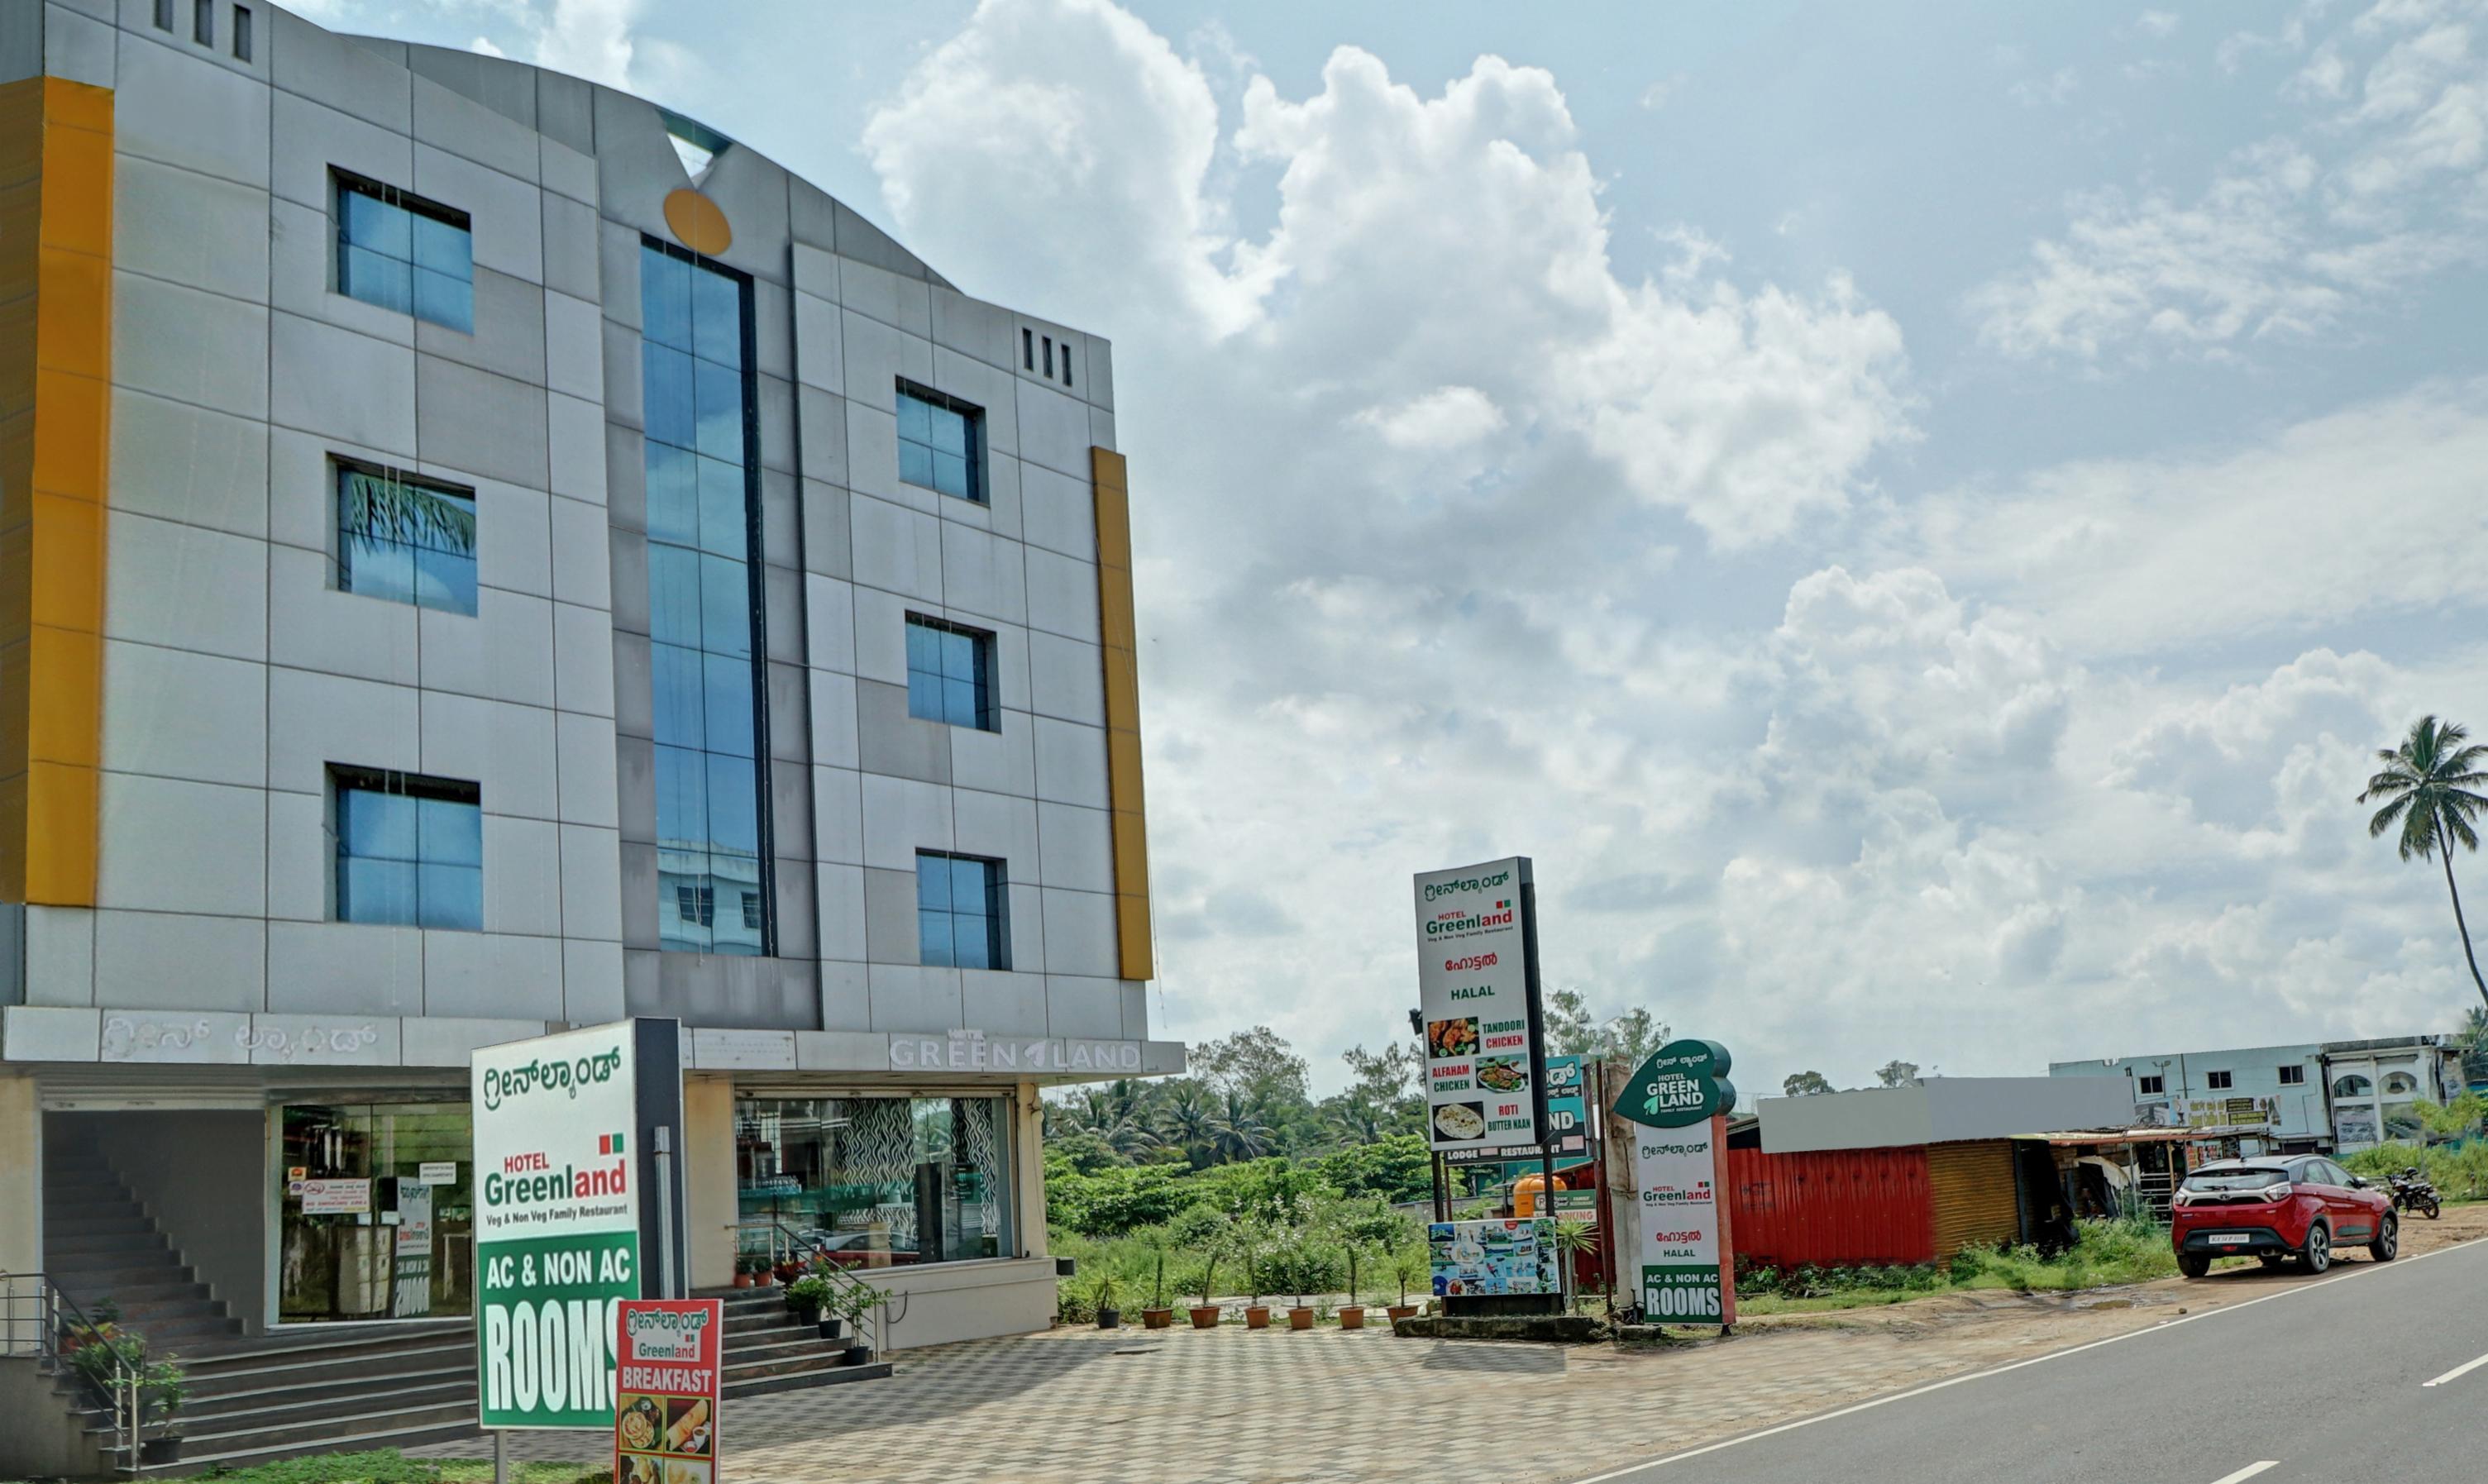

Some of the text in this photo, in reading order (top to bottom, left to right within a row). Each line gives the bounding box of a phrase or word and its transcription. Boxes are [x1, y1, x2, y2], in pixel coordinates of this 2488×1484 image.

[1426, 909, 1512, 934] Greenland
[1438, 911, 1466, 921] HOTEL
[1451, 985, 1495, 1000] HALAL
[1483, 1019, 1525, 1033] TANDOORI
[1486, 1035, 1523, 1048] CHICKEN
[890, 1039, 1141, 1068] GREEN LAND
[1432, 1065, 1469, 1078] ALFAHAM
[1658, 1073, 1686, 1081] HOTEL
[1434, 1080, 1469, 1092] CHICKEN
[1646, 1079, 1699, 1096] GREEN
[1659, 1092, 1704, 1108] LAND
[1498, 1105, 1518, 1116] ROTI
[1488, 1118, 1531, 1132] BUTTER NAAN
[1447, 1144, 1560, 1160] LODGE RESTAURT
[504, 1152, 550, 1174] HOTEL
[485, 1158, 627, 1207] Greenland
[1643, 1189, 1711, 1202] Greenland
[486, 1204, 628, 1228] Veg & Non Veg Family Restaurant
[1664, 1249, 1696, 1257] HALAL
[485, 1248, 631, 1290] AC & NON AC
[1646, 1273, 1718, 1283] AC & NON AC
[1645, 1286, 1721, 1316] ROOMS
[638, 1343, 695, 1359] Greenland
[623, 1366, 712, 1393] BREAKFAST
